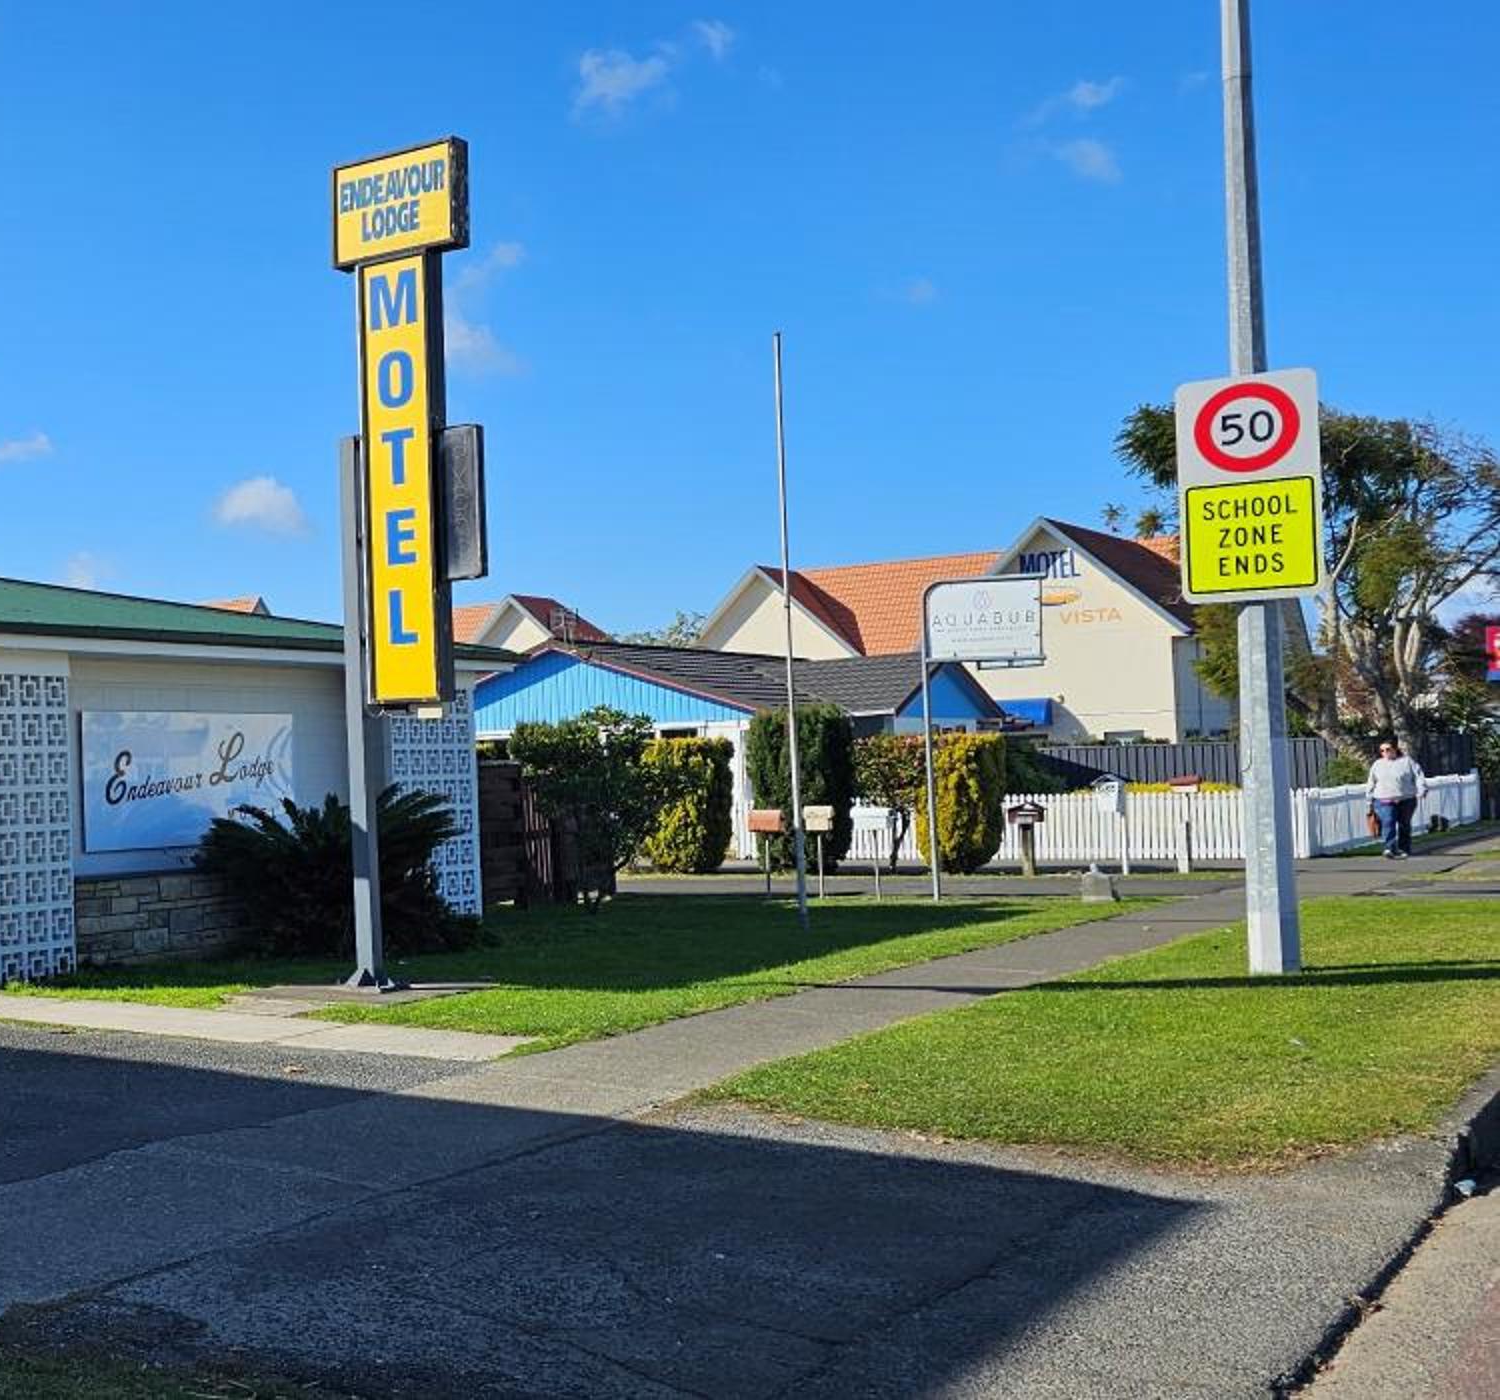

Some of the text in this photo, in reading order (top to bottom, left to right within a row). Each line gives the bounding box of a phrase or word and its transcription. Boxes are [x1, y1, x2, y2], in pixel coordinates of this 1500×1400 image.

[339, 159, 445, 214] ENDEAVOUR
[361, 200, 420, 242] LODGE
[1220, 410, 1275, 447] 50
[369, 267, 418, 646] MOTEL
[1203, 493, 1298, 522] SCHOOL
[1219, 524, 1284, 549] ZONE
[1020, 550, 1080, 578] MOTEL
[1219, 552, 1285, 577] ENDS
[1060, 608, 1123, 624] VISTA
[105, 731, 275, 806] Endeavour Lodge
